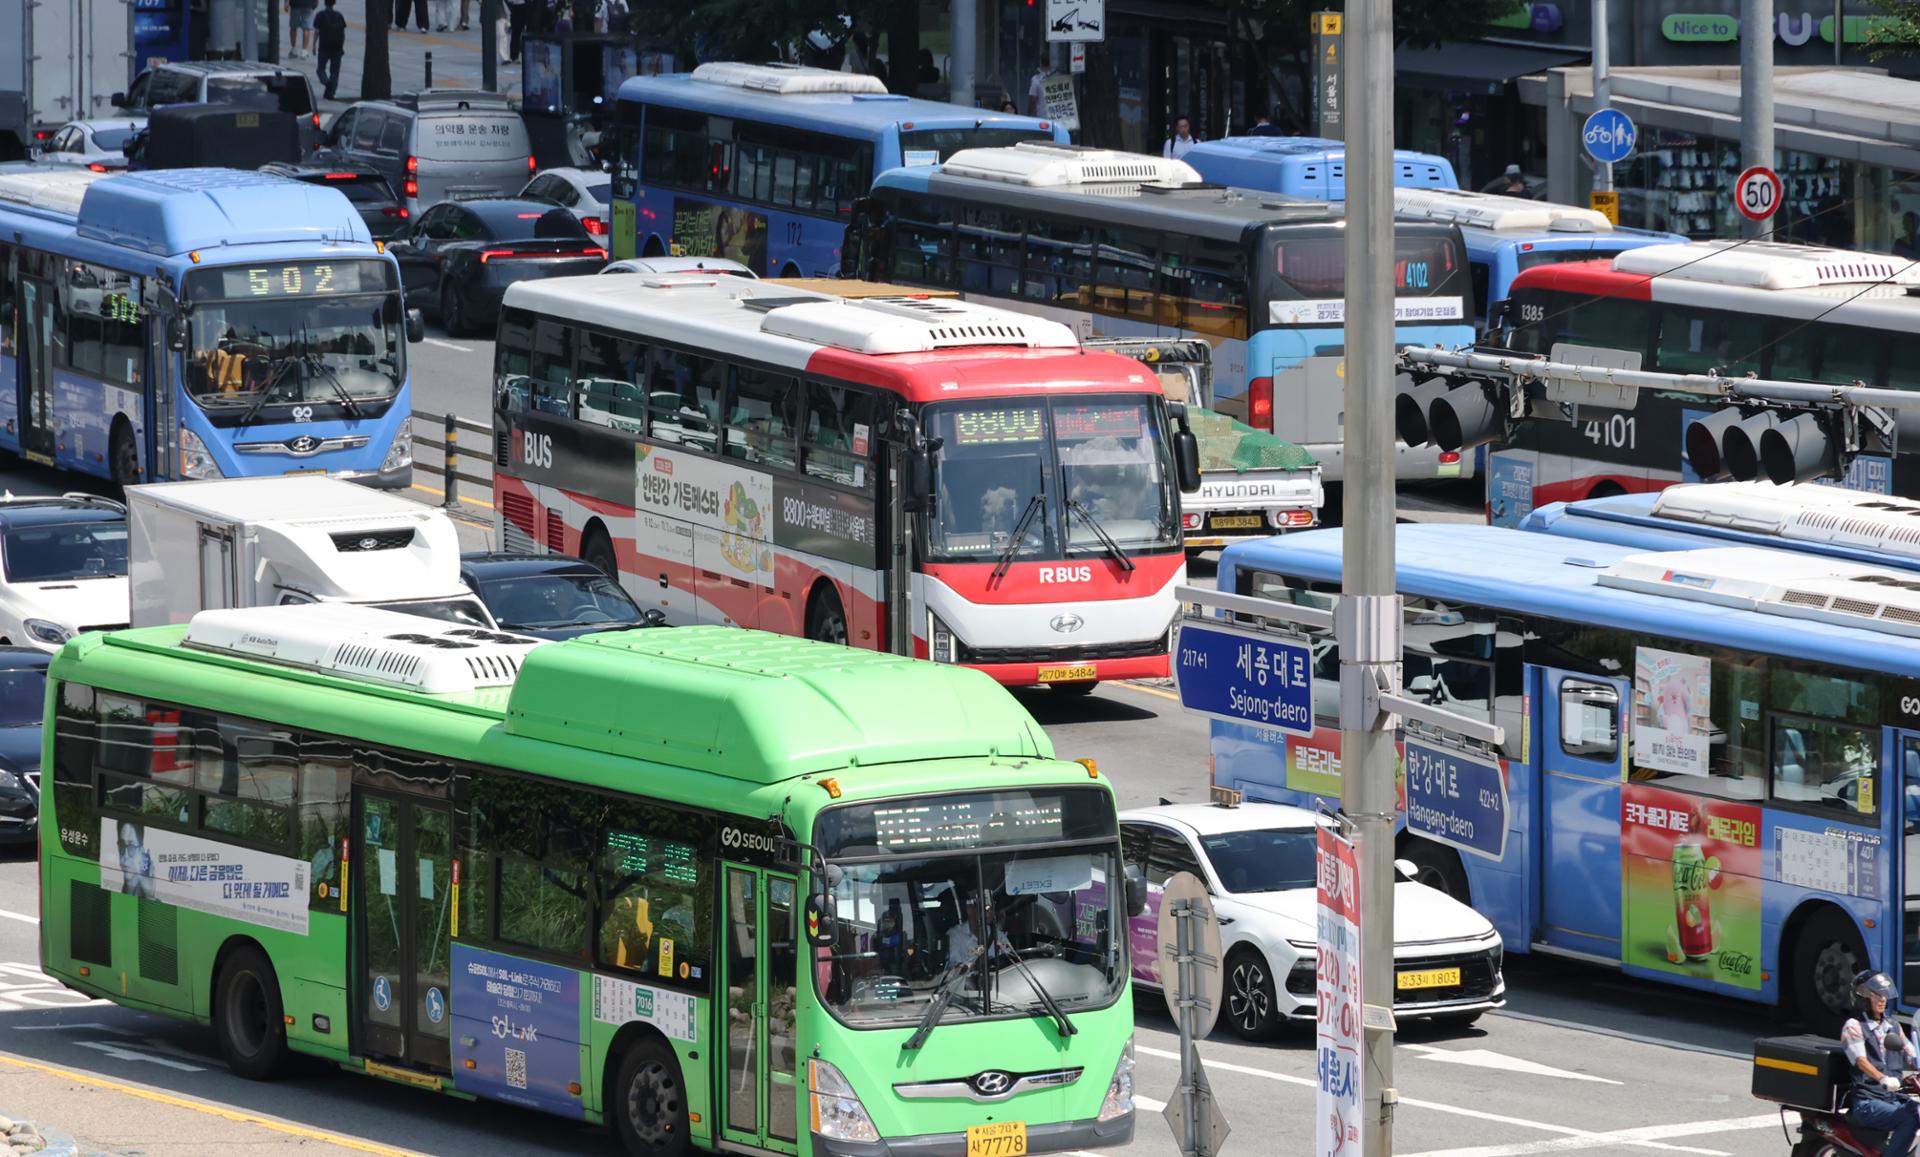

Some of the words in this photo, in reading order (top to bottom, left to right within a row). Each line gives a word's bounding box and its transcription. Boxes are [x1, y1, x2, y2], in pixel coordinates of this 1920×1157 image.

[1673, 19, 1708, 35] Nice
[1711, 21, 1728, 35] to
[1326, 74, 1337, 110] 서울역
[1746, 181, 1772, 207] 50
[787, 222, 802, 245] 172
[1406, 262, 1428, 288] 4102
[1521, 304, 1544, 321] 1385
[1585, 415, 1635, 449] 4101
[643, 473, 671, 506] 한탄강
[1203, 485, 1276, 497] HYUNDAI
[784, 497, 806, 527] 8800
[1068, 668, 1092, 678] 5484
[1236, 645, 1308, 689] 세종대로
[1230, 687, 1308, 724] Sejong-daero
[1295, 745, 1341, 776] 칼로리는
[1408, 751, 1460, 799] 한강대로
[1409, 797, 1474, 839] Hangang-daero
[1625, 802, 1667, 828] 코카-콜라
[1669, 809, 1689, 833] 제로
[1707, 815, 1755, 847] 레몬라임
[61, 828, 89, 847] 유성운수
[742, 836, 776, 853] SEOUL
[1431, 971, 1457, 984] 1803
[636, 995, 653, 1011] 7016
